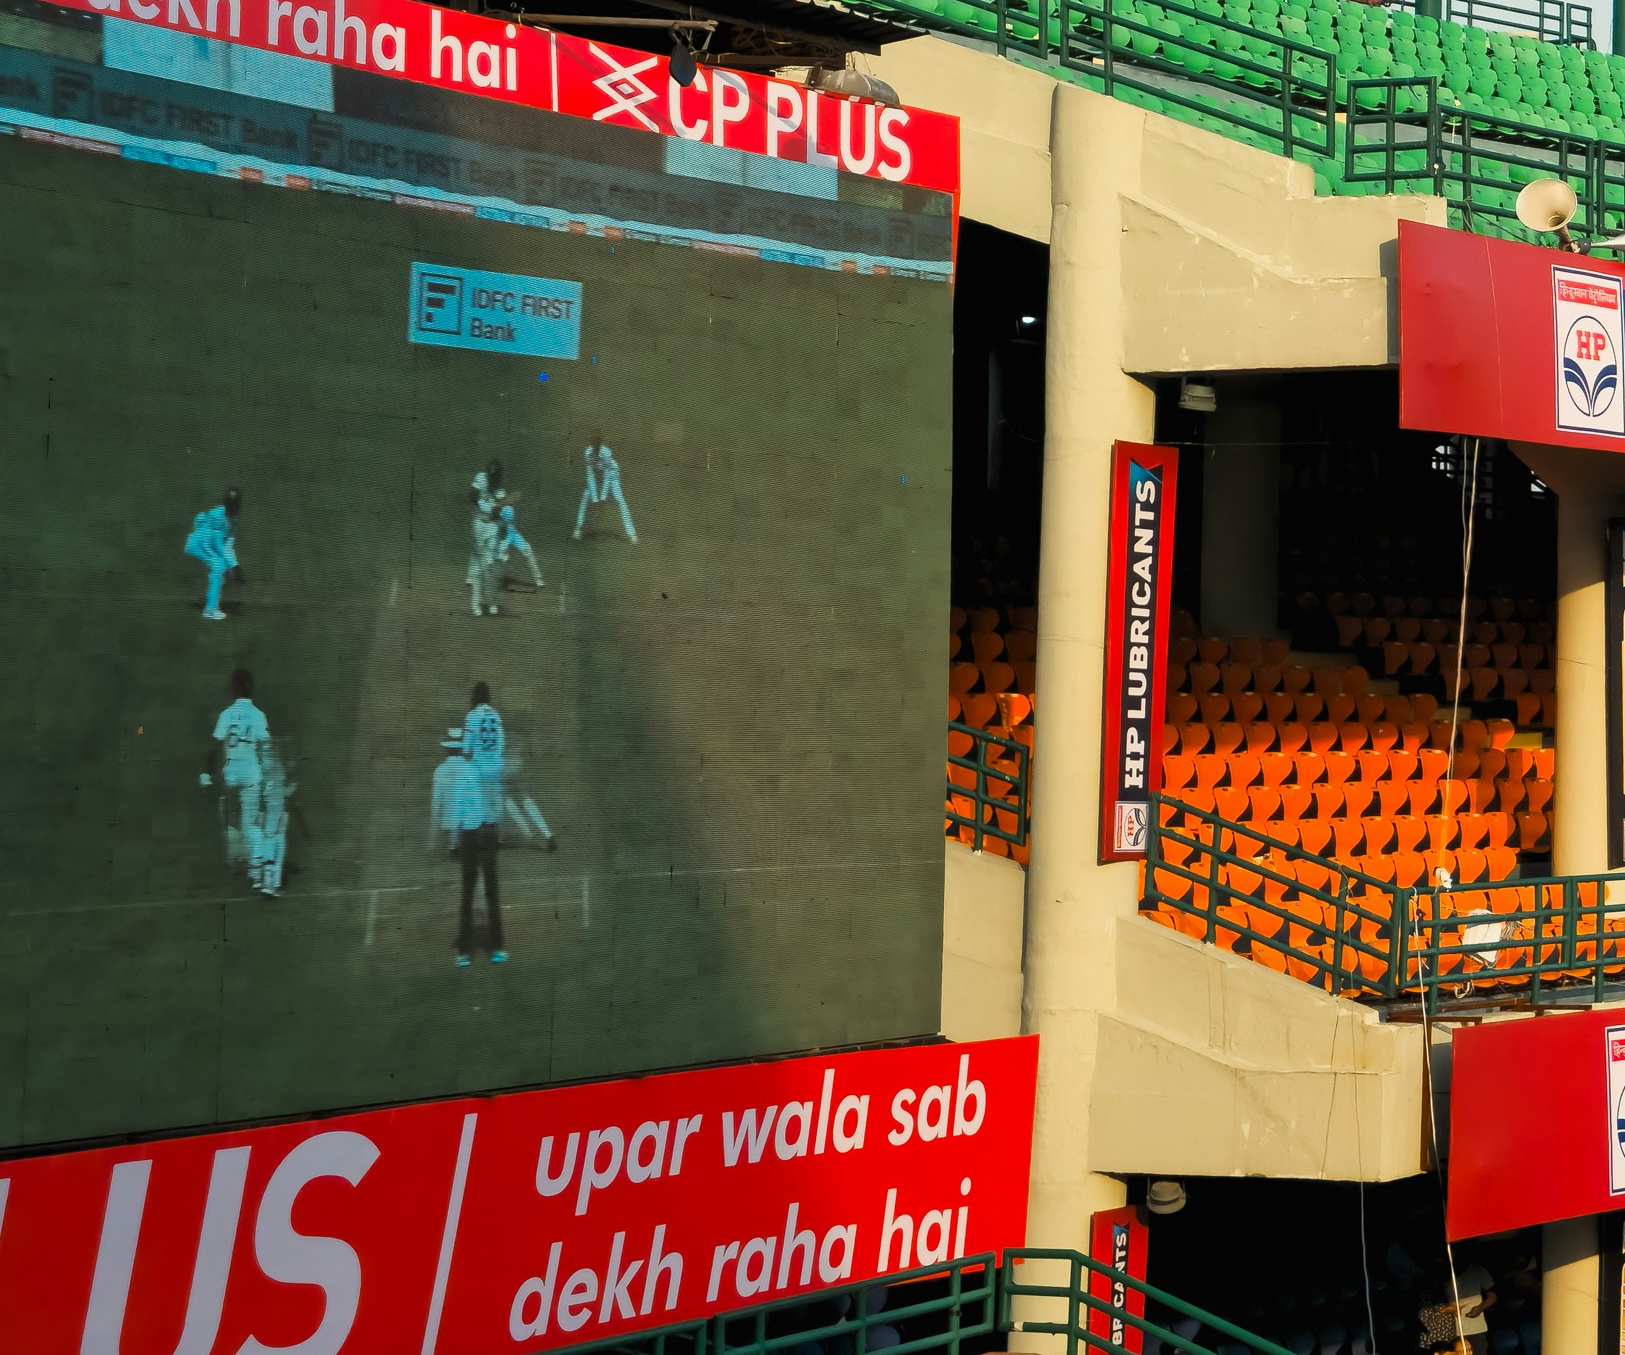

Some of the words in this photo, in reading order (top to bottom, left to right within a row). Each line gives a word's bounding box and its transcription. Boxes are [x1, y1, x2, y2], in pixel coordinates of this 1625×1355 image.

[431, 11, 518, 93] hai
[670, 74, 748, 145] CP
[766, 87, 911, 182] PLUS
[470, 318, 516, 342] Bank
[472, 289, 515, 313] IDFC
[521, 294, 574, 320] FIRST
[1576, 329, 1606, 361] HP
[1125, 479, 1157, 720] LUBRICANTS
[1124, 727, 1146, 790] HP
[534, 1113, 702, 1216] upar
[720, 1069, 866, 1168] wala
[887, 1053, 986, 1147] sab
[507, 1224, 682, 1343] dekh
[706, 1202, 857, 1303] raha
[876, 1178, 971, 1268] hai
